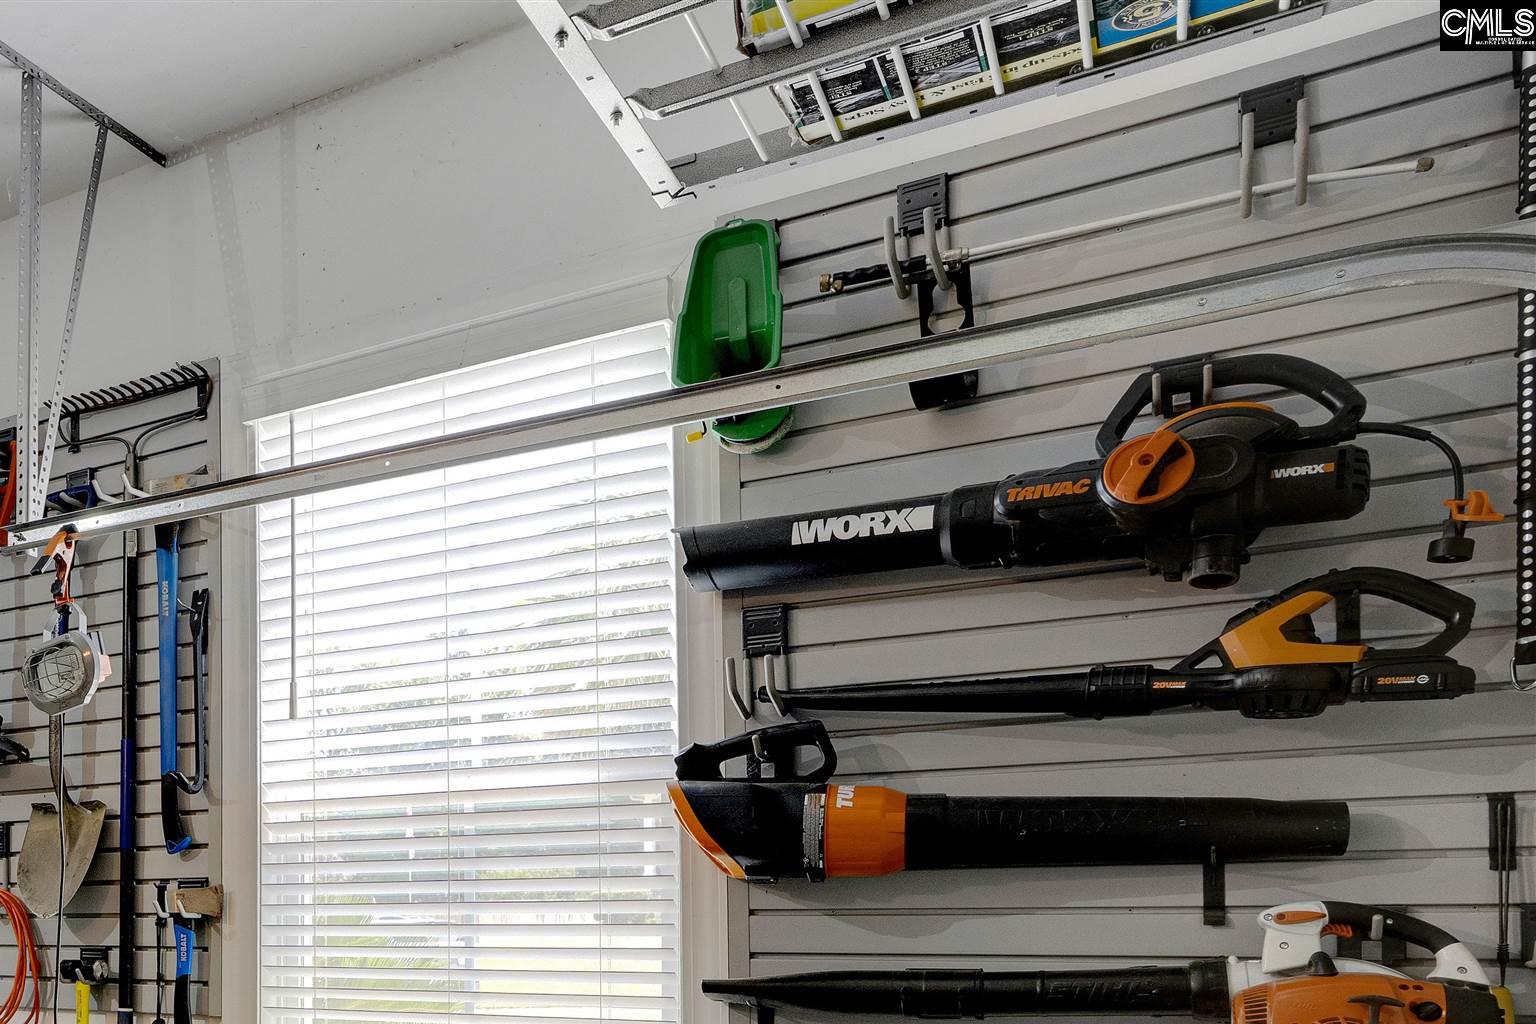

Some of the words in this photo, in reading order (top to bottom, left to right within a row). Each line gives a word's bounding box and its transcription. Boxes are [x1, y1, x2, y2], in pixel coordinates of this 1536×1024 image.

[1270, 463, 1326, 479] WORX
[1006, 478, 1092, 502] TRIVAC
[791, 505, 920, 546] WORX
[161, 580, 169, 617] KOBALT
